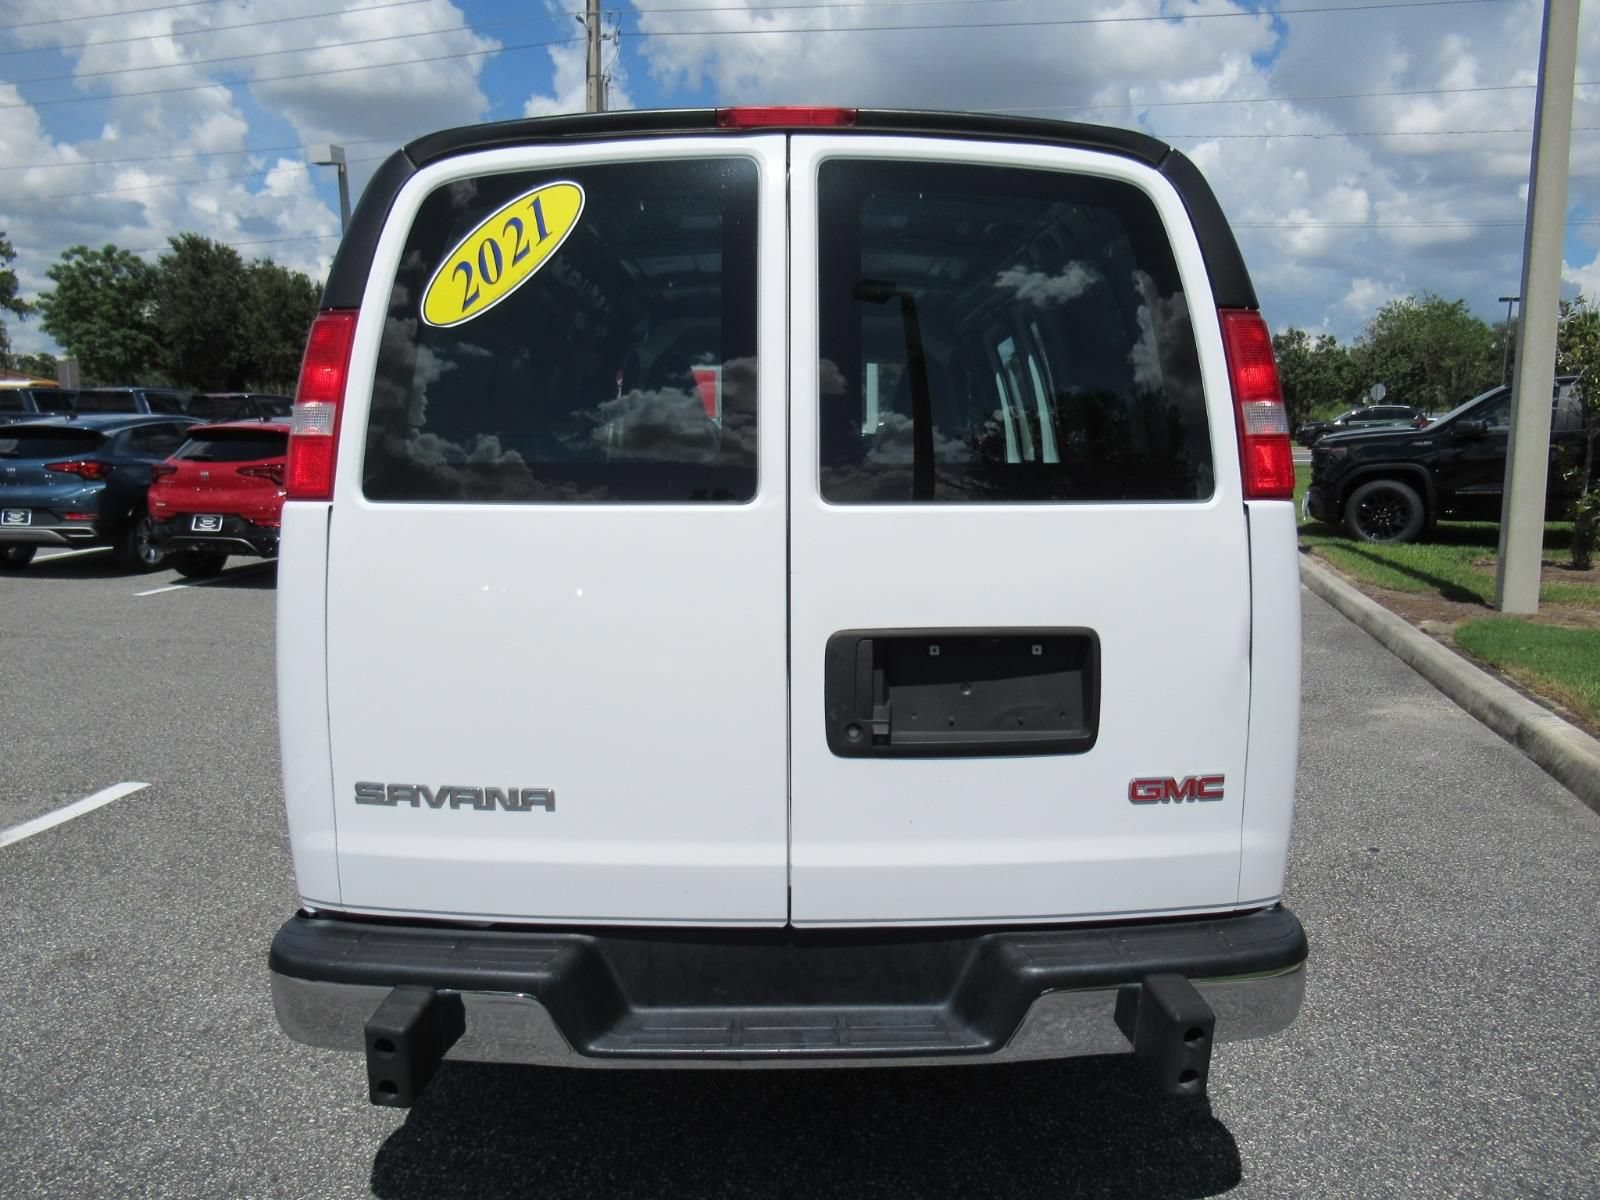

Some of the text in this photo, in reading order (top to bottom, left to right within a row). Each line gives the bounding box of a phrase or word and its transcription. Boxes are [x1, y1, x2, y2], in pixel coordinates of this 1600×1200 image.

[452, 195, 553, 313] 2021
[355, 781, 555, 812] SAVANA
[1128, 773, 1224, 804] GMC
